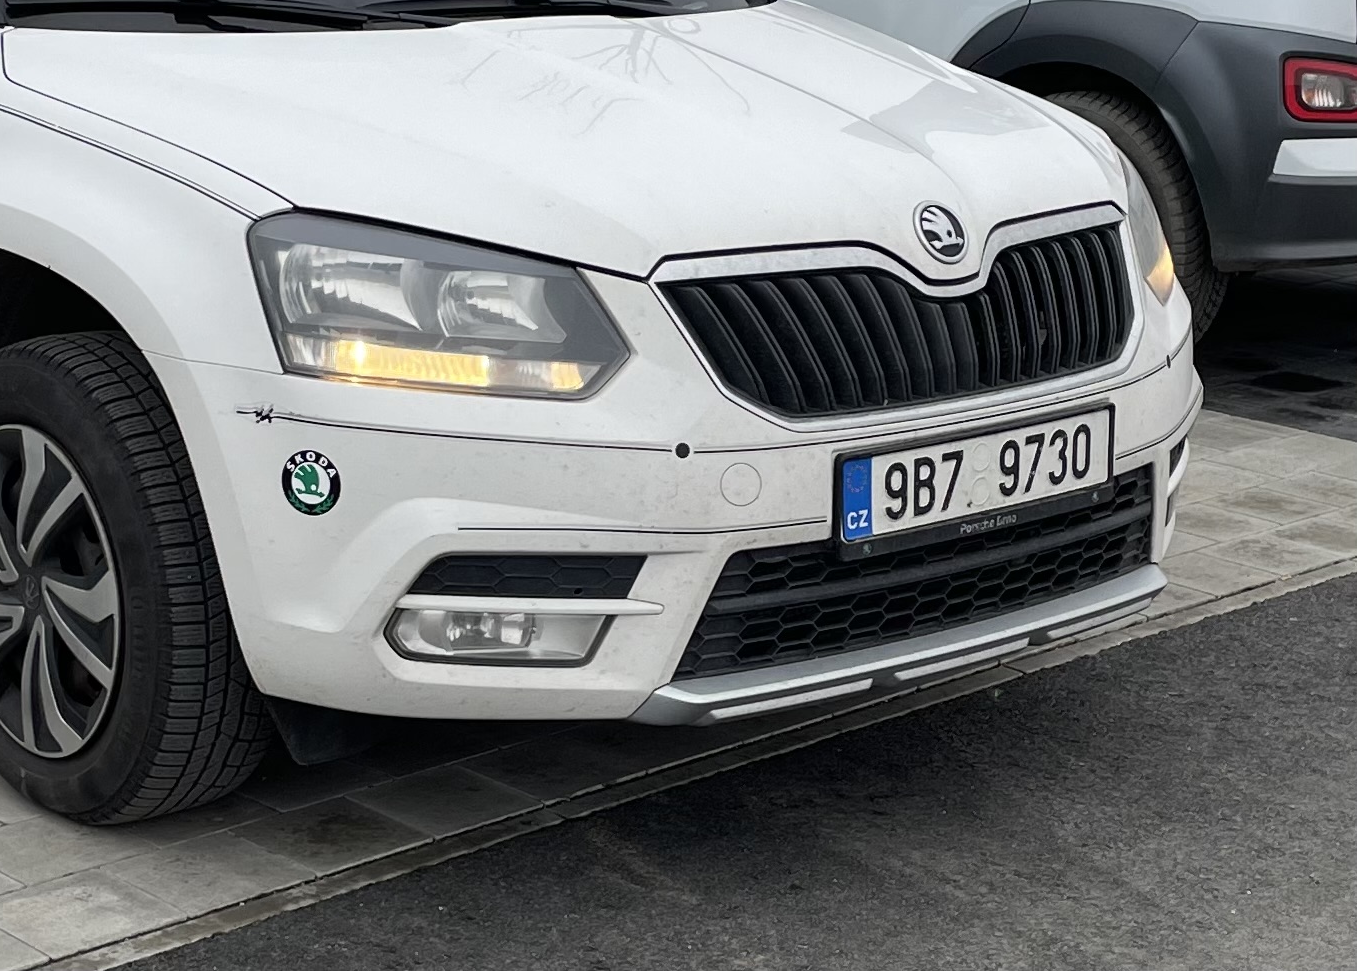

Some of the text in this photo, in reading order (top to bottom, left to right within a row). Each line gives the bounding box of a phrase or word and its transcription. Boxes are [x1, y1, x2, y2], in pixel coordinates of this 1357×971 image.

[884, 423, 1092, 520] 9B7 9730
[847, 509, 869, 529] CZ
